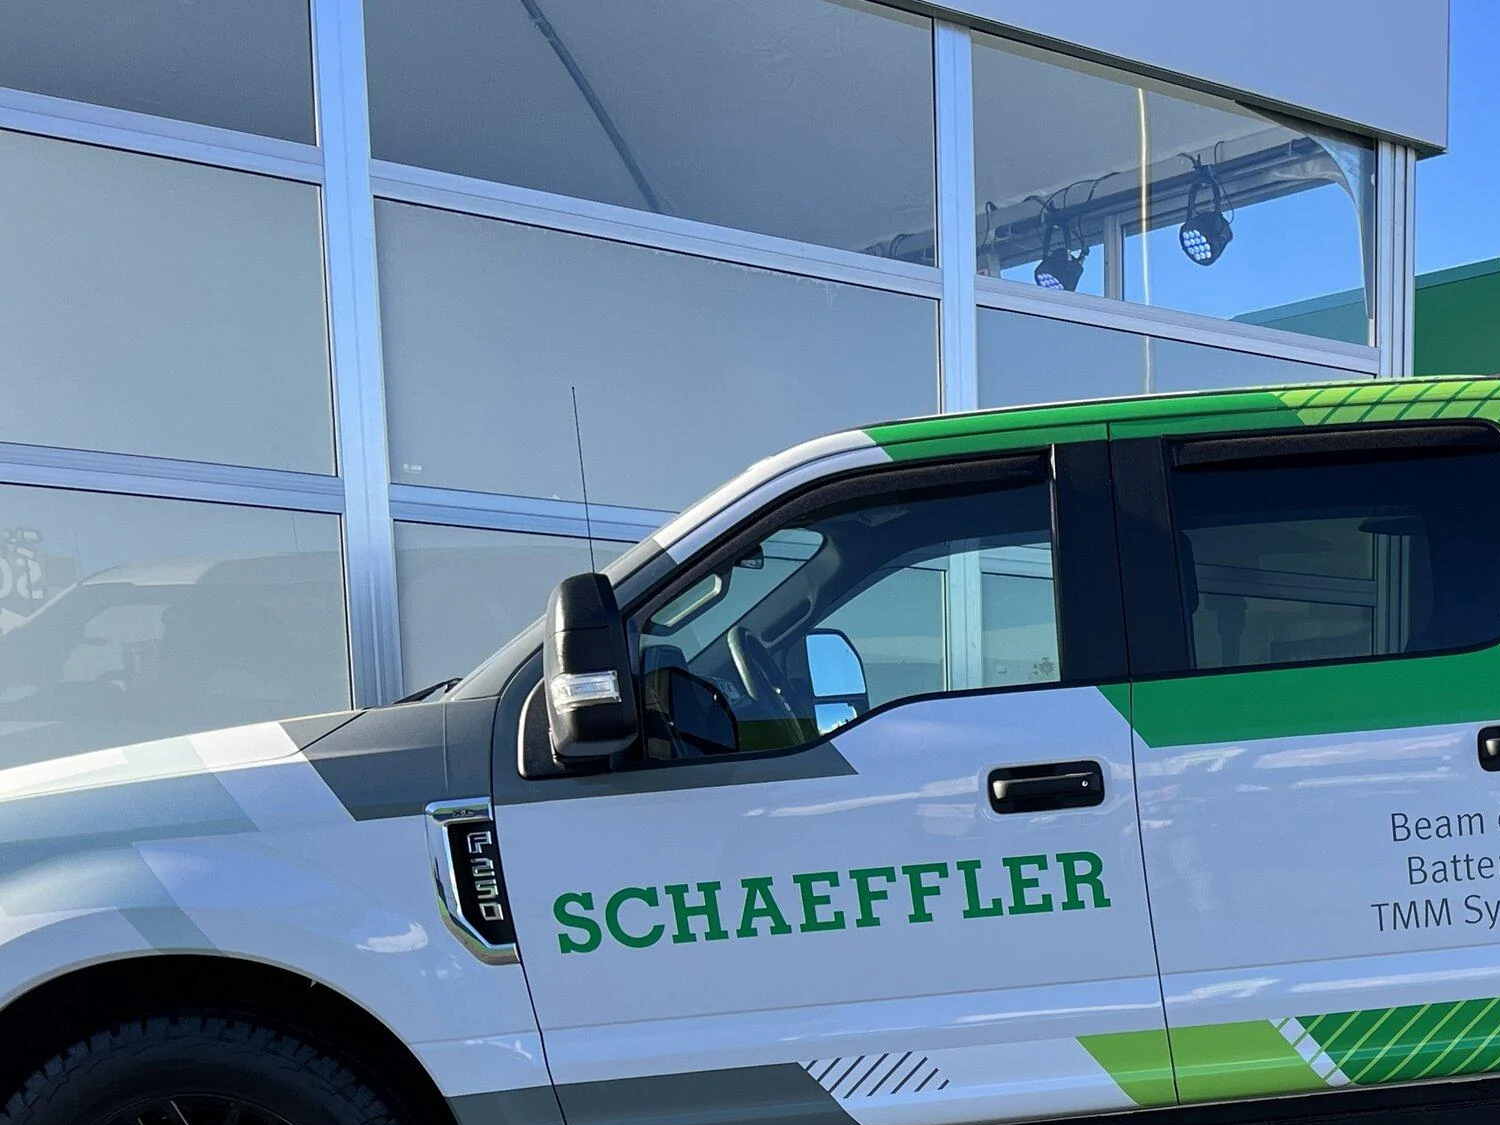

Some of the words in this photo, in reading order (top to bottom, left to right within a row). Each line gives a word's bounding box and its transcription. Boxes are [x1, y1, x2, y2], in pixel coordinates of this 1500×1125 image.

[1391, 812, 1485, 842] Beam
[553, 850, 1111, 955] SCHAEFFLER
[1371, 898, 1452, 932] TMM
